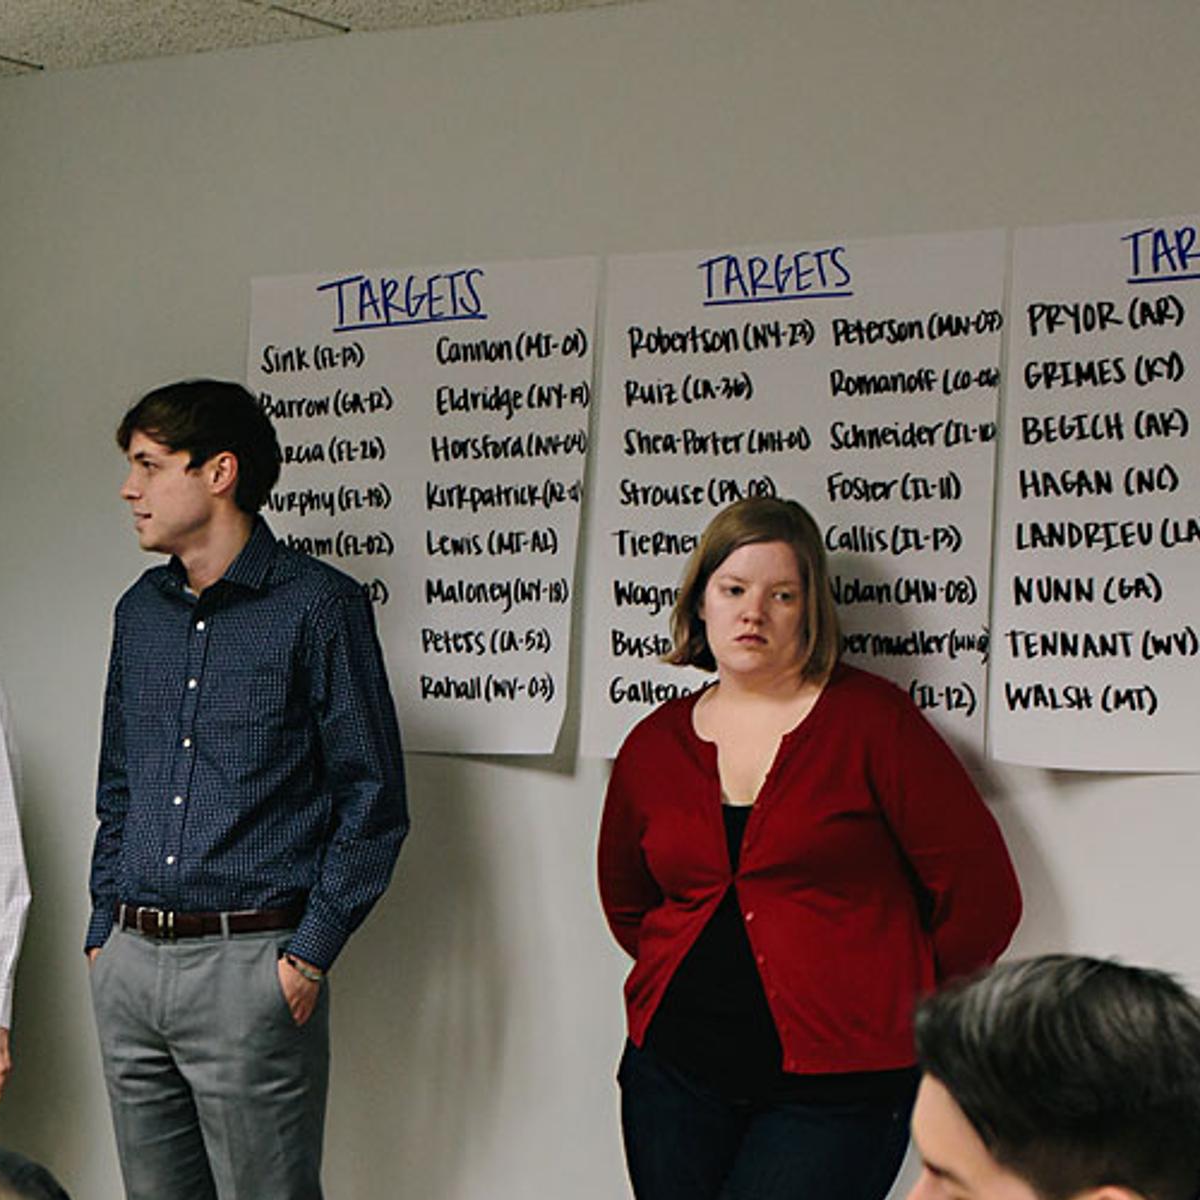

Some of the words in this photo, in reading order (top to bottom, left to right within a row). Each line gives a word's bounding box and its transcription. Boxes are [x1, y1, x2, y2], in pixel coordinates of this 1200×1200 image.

[697, 246, 851, 299] TARGETS
[317, 269, 485, 326] TARGETS
[1028, 302, 1123, 336] PRYOR
[1129, 295, 1185, 330] (AR)
[628, 325, 739, 358] Robertson
[832, 318, 924, 346] Peterson
[261, 345, 310, 374] Sink
[436, 336, 512, 365] Cannon
[830, 368, 938, 396] Romanoff
[1024, 357, 1126, 389] GRIMES
[1135, 351, 1185, 386] (KY)
[436, 386, 523, 420] Eldridge
[625, 379, 678, 407] Ruiz
[830, 421, 943, 450] Schneider
[1022, 413, 1124, 445] BEGICH
[1135, 408, 1189, 439] (AK)
[432, 434, 524, 462] Horsford
[620, 479, 704, 506] Strouse
[827, 472, 899, 501] Foster
[1020, 469, 1113, 499] HAGAN
[1124, 463, 1179, 496] (NC)
[427, 481, 542, 512] Kirkpatrick
[427, 530, 483, 555] Lewis
[611, 529, 698, 556] Tierne
[825, 525, 888, 551] Callis
[1016, 522, 1153, 552] LANDRIEU
[1161, 516, 1200, 548] (LA
[426, 578, 512, 613] Maloney
[1014, 575, 1094, 605] NUNN
[1104, 572, 1162, 604] (GA)
[422, 628, 485, 655] Peters
[1005, 630, 1133, 659] TENNANT
[1142, 626, 1199, 660] (WV)
[420, 674, 481, 700] Rahall
[1005, 682, 1093, 711] WALSH
[1101, 684, 1158, 716] (MT)
